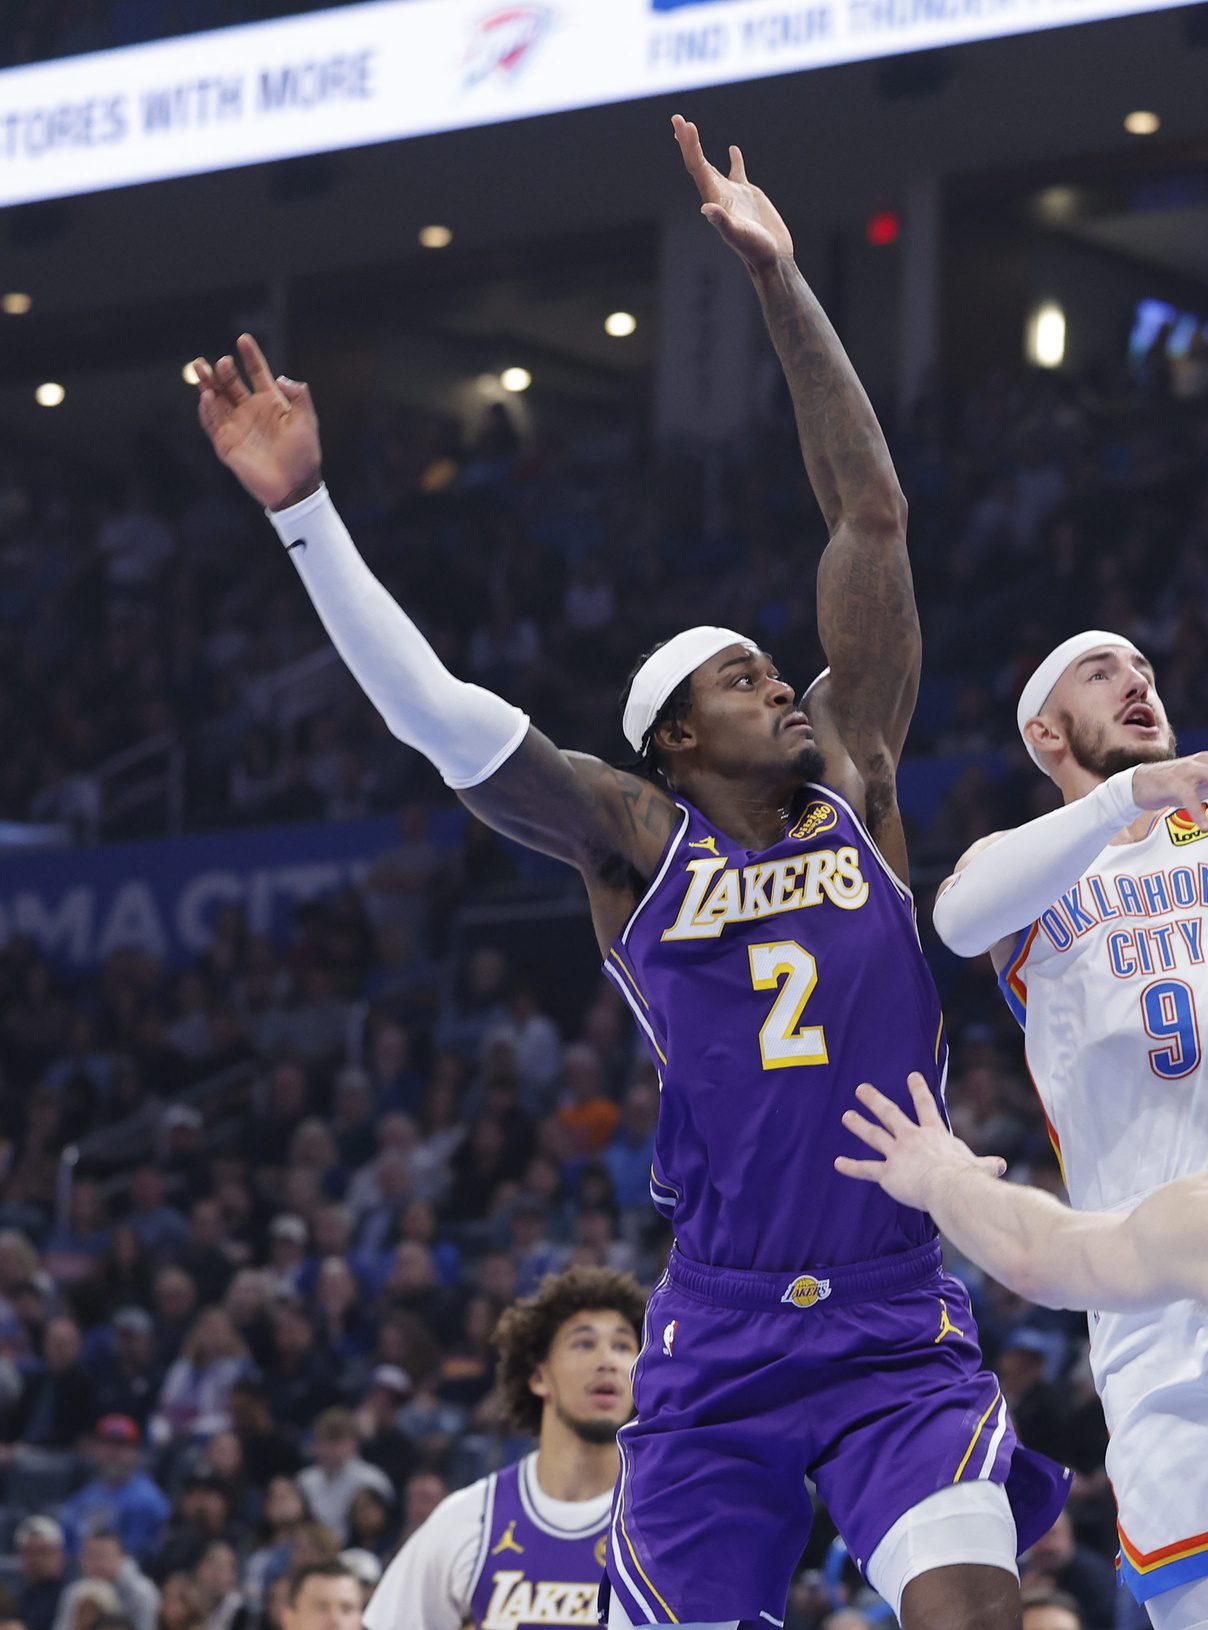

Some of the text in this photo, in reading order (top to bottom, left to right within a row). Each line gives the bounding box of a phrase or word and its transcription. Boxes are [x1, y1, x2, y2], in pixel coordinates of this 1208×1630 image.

[646, 24, 731, 70] FIND
[738, 7, 834, 54] YOUR
[0, 48, 378, 160] TORES WITH MORE
[792, 805, 831, 838] bibigo
[660, 847, 869, 942] LAKERS
[1107, 917, 1205, 978] CITY
[748, 940, 829, 1070] 2
[1140, 978, 1201, 1081] 9
